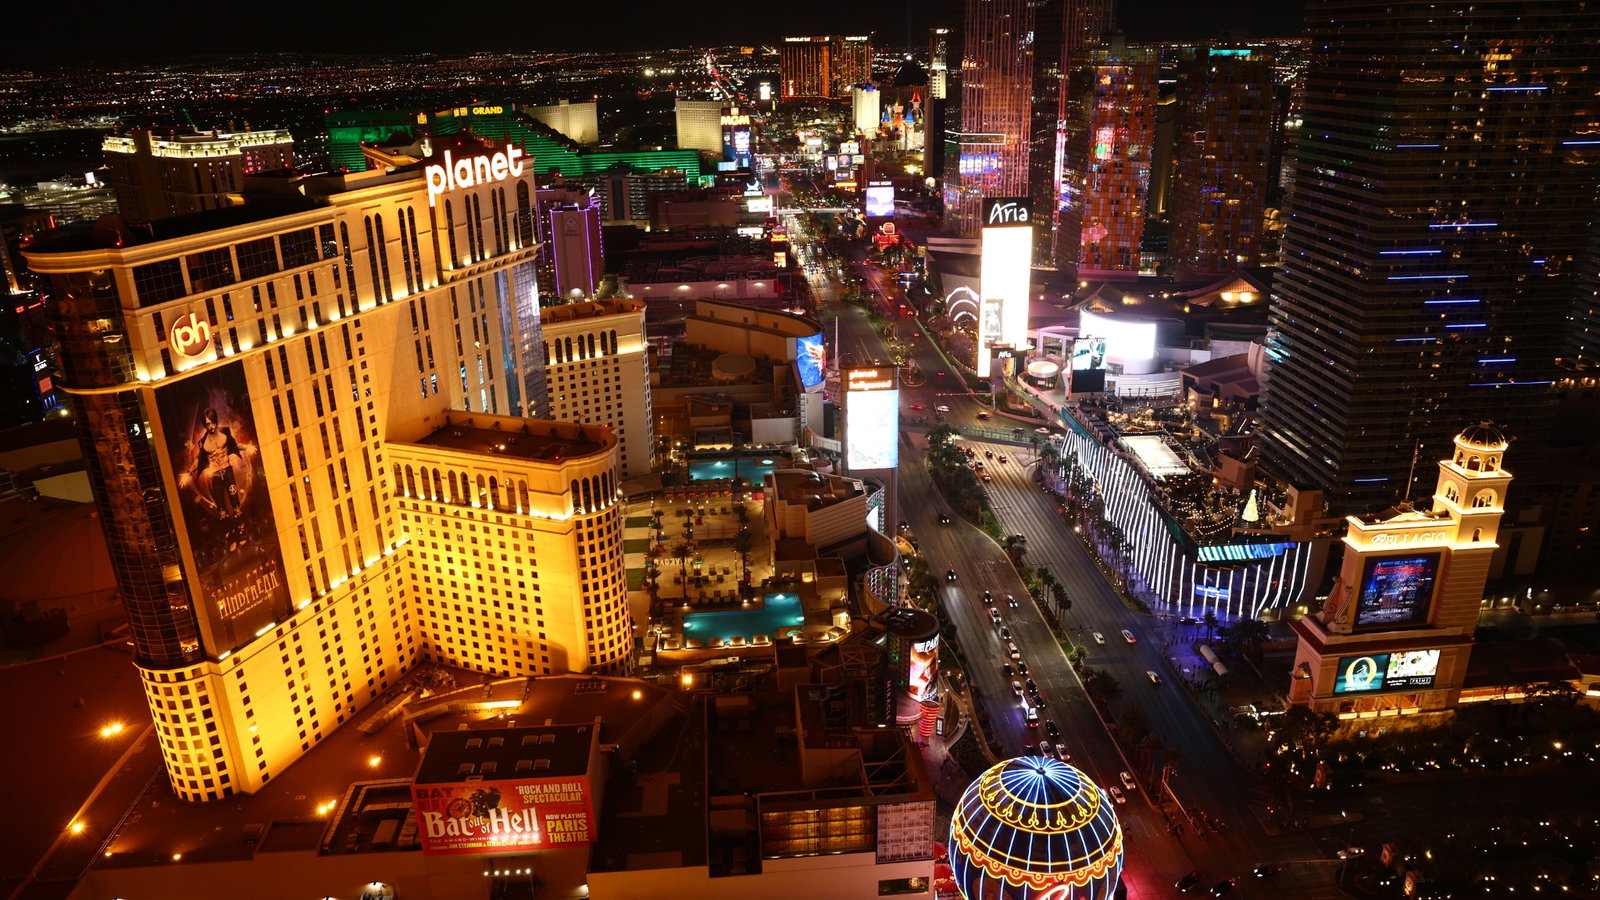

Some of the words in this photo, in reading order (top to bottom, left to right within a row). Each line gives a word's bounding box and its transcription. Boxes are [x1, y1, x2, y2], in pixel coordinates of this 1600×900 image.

[472, 106, 503, 115] GRAND
[720, 115, 750, 126] MGM
[425, 143, 524, 207] planet
[989, 202, 1028, 224] Aria
[849, 369, 878, 380] planet
[849, 379, 892, 391] hollywood
[1371, 531, 1448, 546] BELLAGIO
[216, 570, 281, 620] MINDFREAK
[543, 784, 561, 794] AND
[562, 783, 583, 793] ROLL
[422, 811, 475, 838] Bat
[468, 816, 485, 828] out
[481, 822, 491, 834] of
[487, 806, 540, 835] Hell
[560, 812, 587, 820] PLAYING
[546, 819, 588, 832] PARIS
[547, 831, 590, 844] THEATRE
